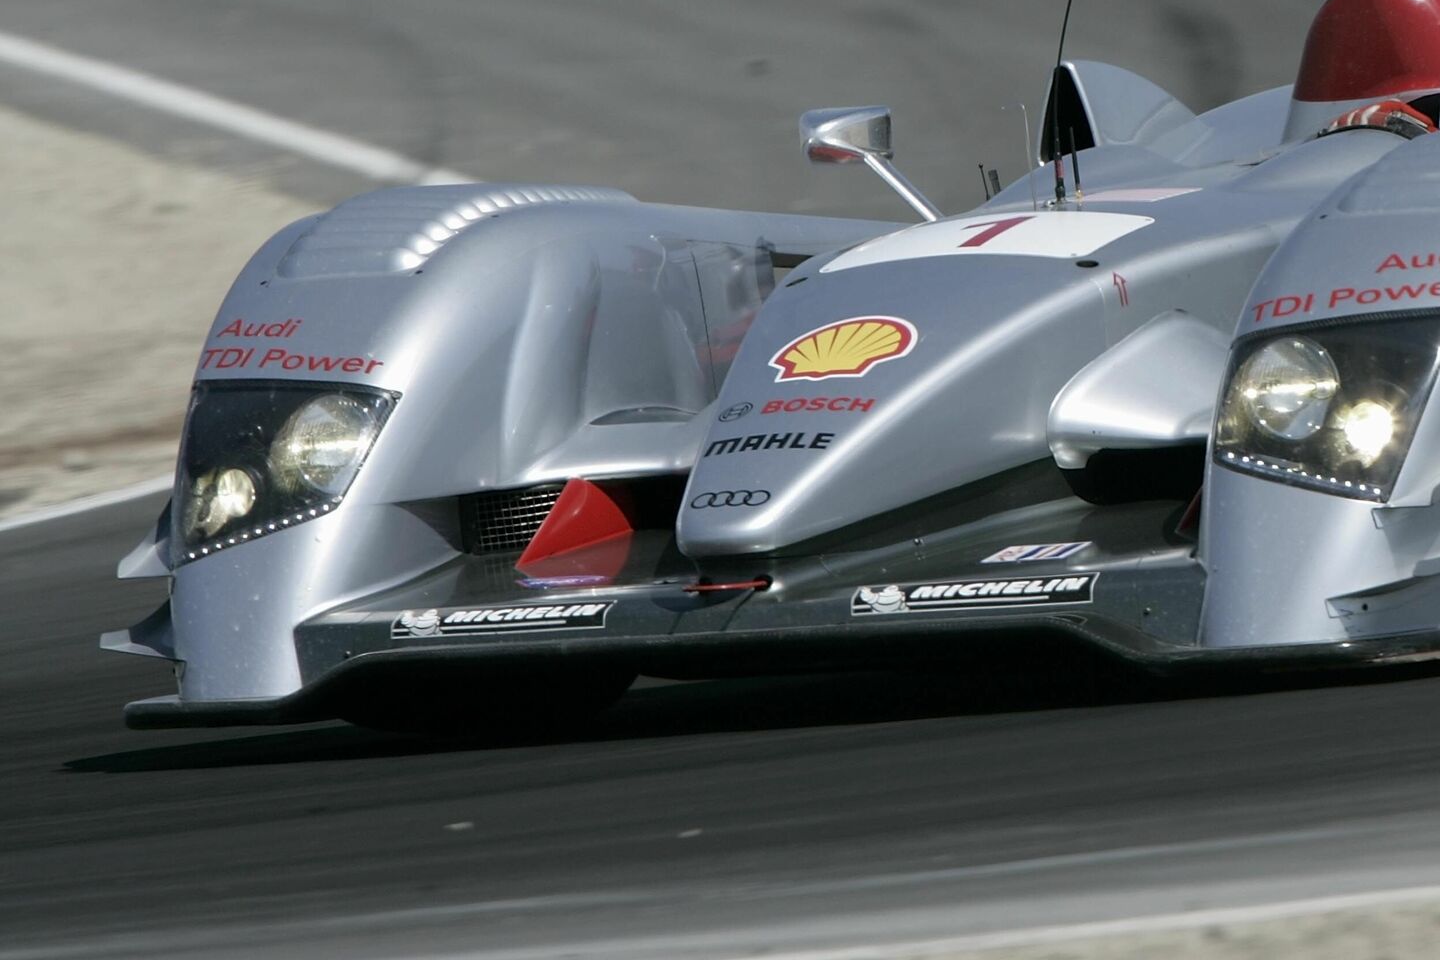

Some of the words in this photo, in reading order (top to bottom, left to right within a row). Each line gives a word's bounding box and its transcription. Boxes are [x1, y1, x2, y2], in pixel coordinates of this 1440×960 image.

[957, 215, 1037, 247] 1
[1251, 293, 1315, 321] TDI
[217, 319, 302, 337] Audi
[201, 348, 255, 369] TDI
[259, 348, 384, 375] Power
[760, 396, 875, 415] BOSCH
[704, 432, 835, 458] MAHLE
[909, 576, 1090, 599] MICHELIN
[444, 604, 607, 623] MICHELIN
